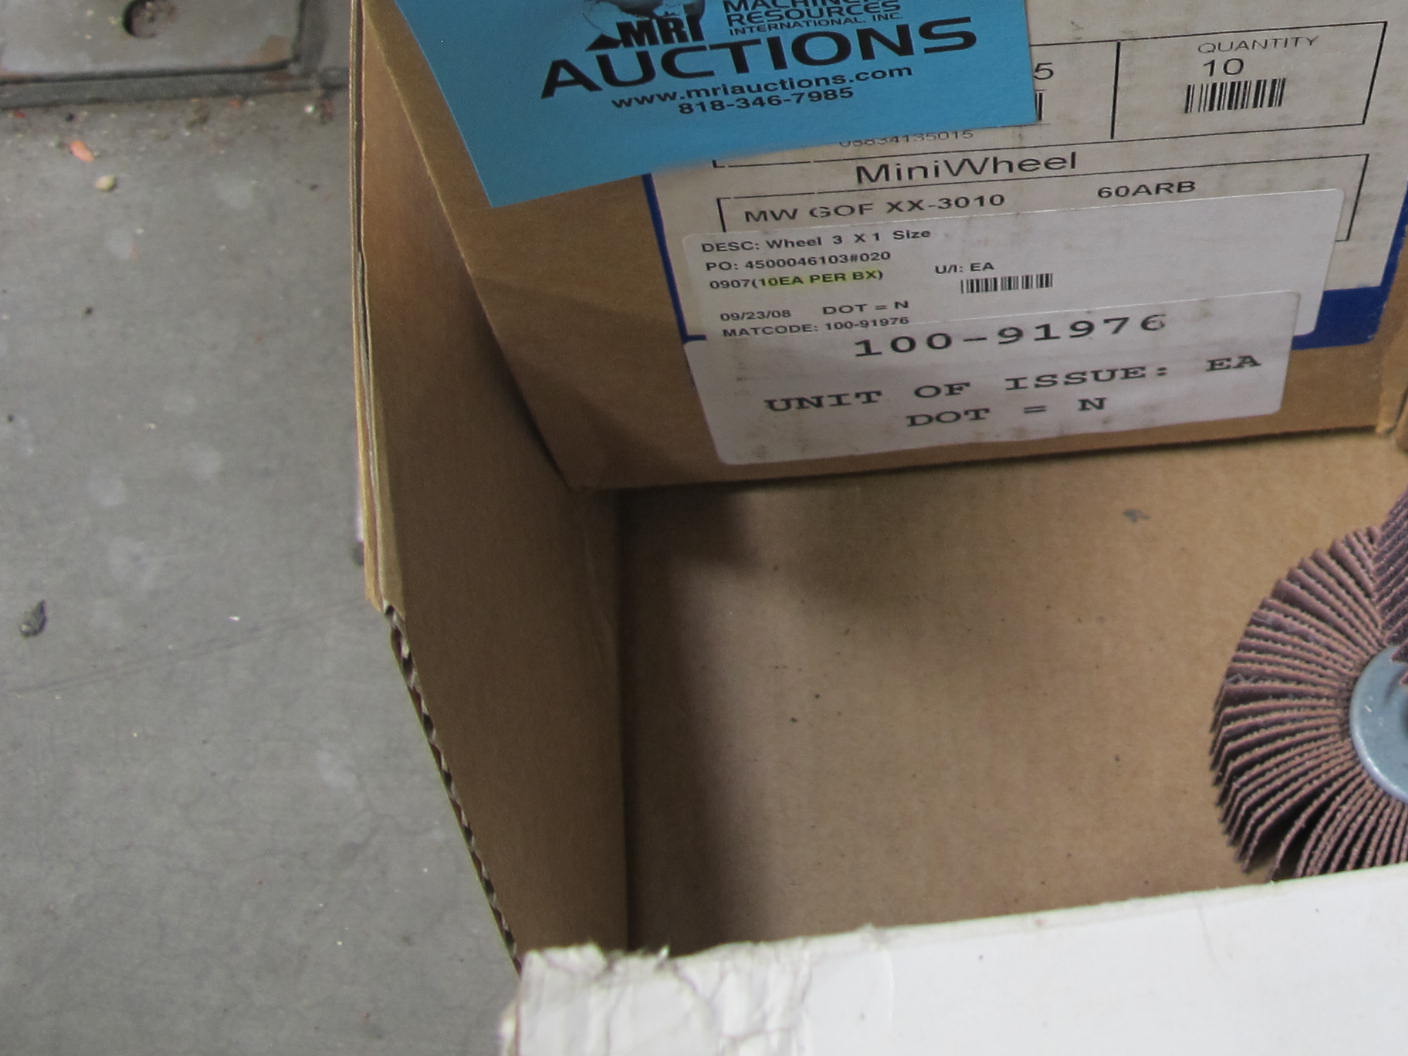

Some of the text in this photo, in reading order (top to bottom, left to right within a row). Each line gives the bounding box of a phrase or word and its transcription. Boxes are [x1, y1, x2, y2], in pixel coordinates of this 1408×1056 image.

[726, 0, 901, 25] RESOURCES
[617, 7, 705, 47] MRI
[540, 17, 978, 99] AUCTIONS
[1197, 36, 1320, 54] QUANTITY
[1202, 58, 1245, 77] 10
[611, 65, 912, 109] www.mriauctions.com
[678, 87, 854, 115] 818-346-7985
[855, 152, 1077, 185] MiniWheel
[744, 181, 1196, 223] MW GOF XX-3010 60ARB
[701, 241, 759, 253] DESC:
[766, 236, 822, 249] Wheel
[833, 235, 842, 245] 3
[854, 233, 866, 243] X
[893, 227, 931, 240] Size
[706, 251, 891, 271] PO: 4500046103#020
[709, 274, 803, 289] 0907(10EA
[810, 272, 846, 284] PER
[852, 269, 884, 281] BX)
[970, 262, 994, 272] EA
[720, 309, 792, 322] 09/23/08
[822, 303, 869, 315] DOT
[894, 300, 909, 310] N
[722, 316, 910, 338] MATCODE: 100-91976
[854, 313, 1168, 357] 100-91976
[764, 354, 1262, 413] UNIT OF ISSUE: EA
[906, 397, 1107, 427] DOT = N
